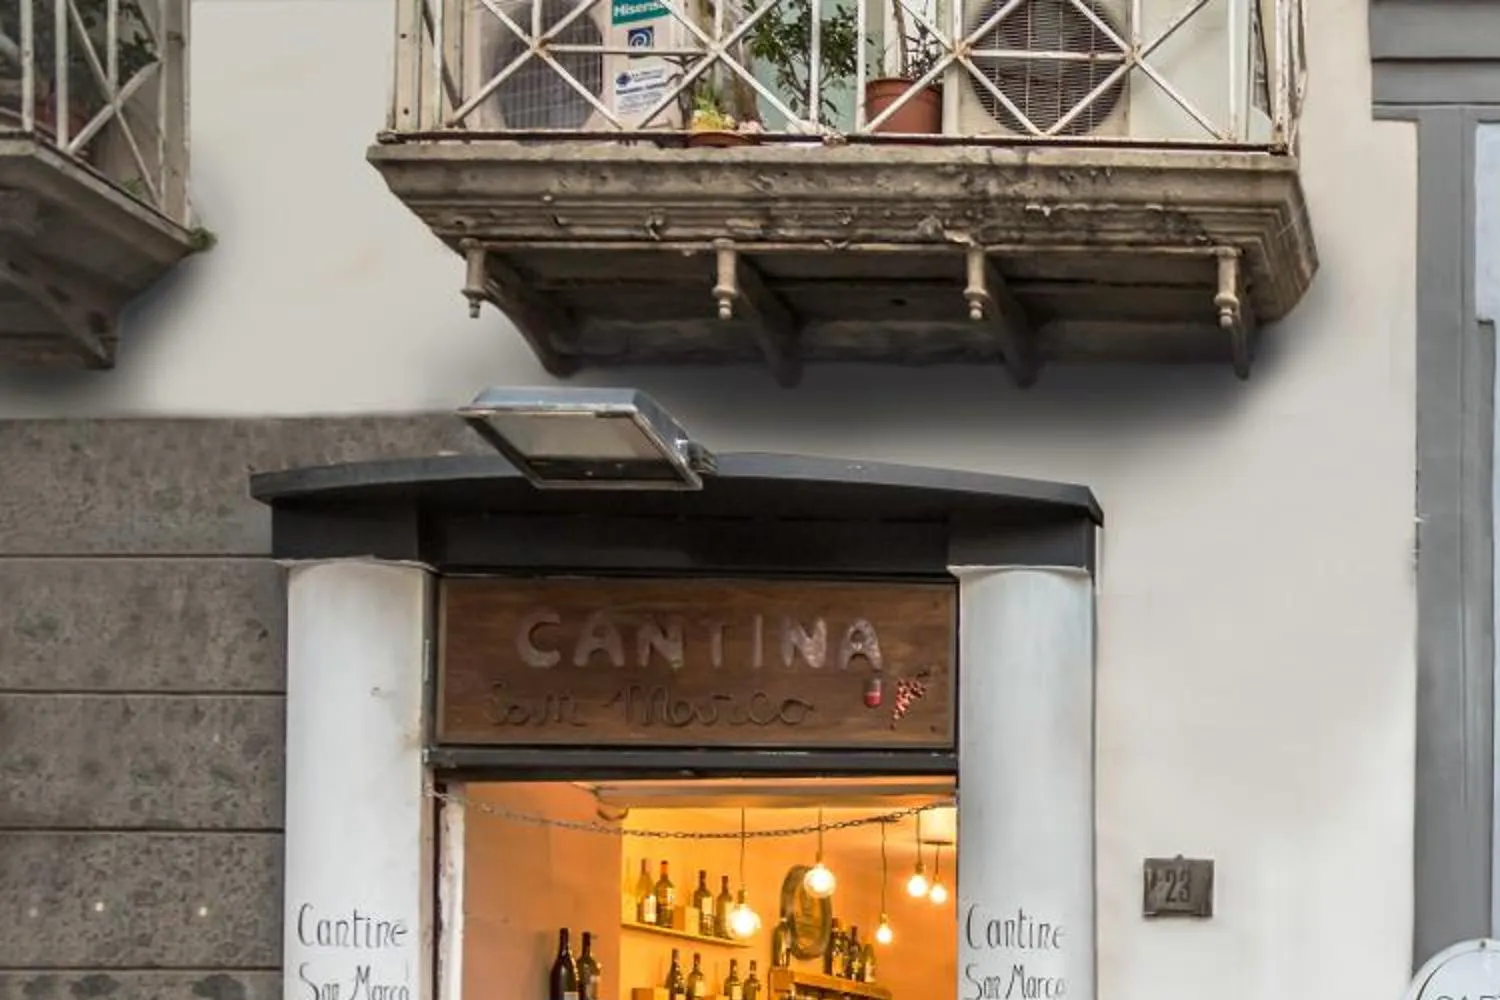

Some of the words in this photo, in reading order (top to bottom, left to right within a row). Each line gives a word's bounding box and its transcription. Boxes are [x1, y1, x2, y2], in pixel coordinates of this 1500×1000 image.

[515, 611, 883, 670] CANTINA
[297, 902, 409, 948] Cantine
[966, 903, 1065, 950] Cantine
